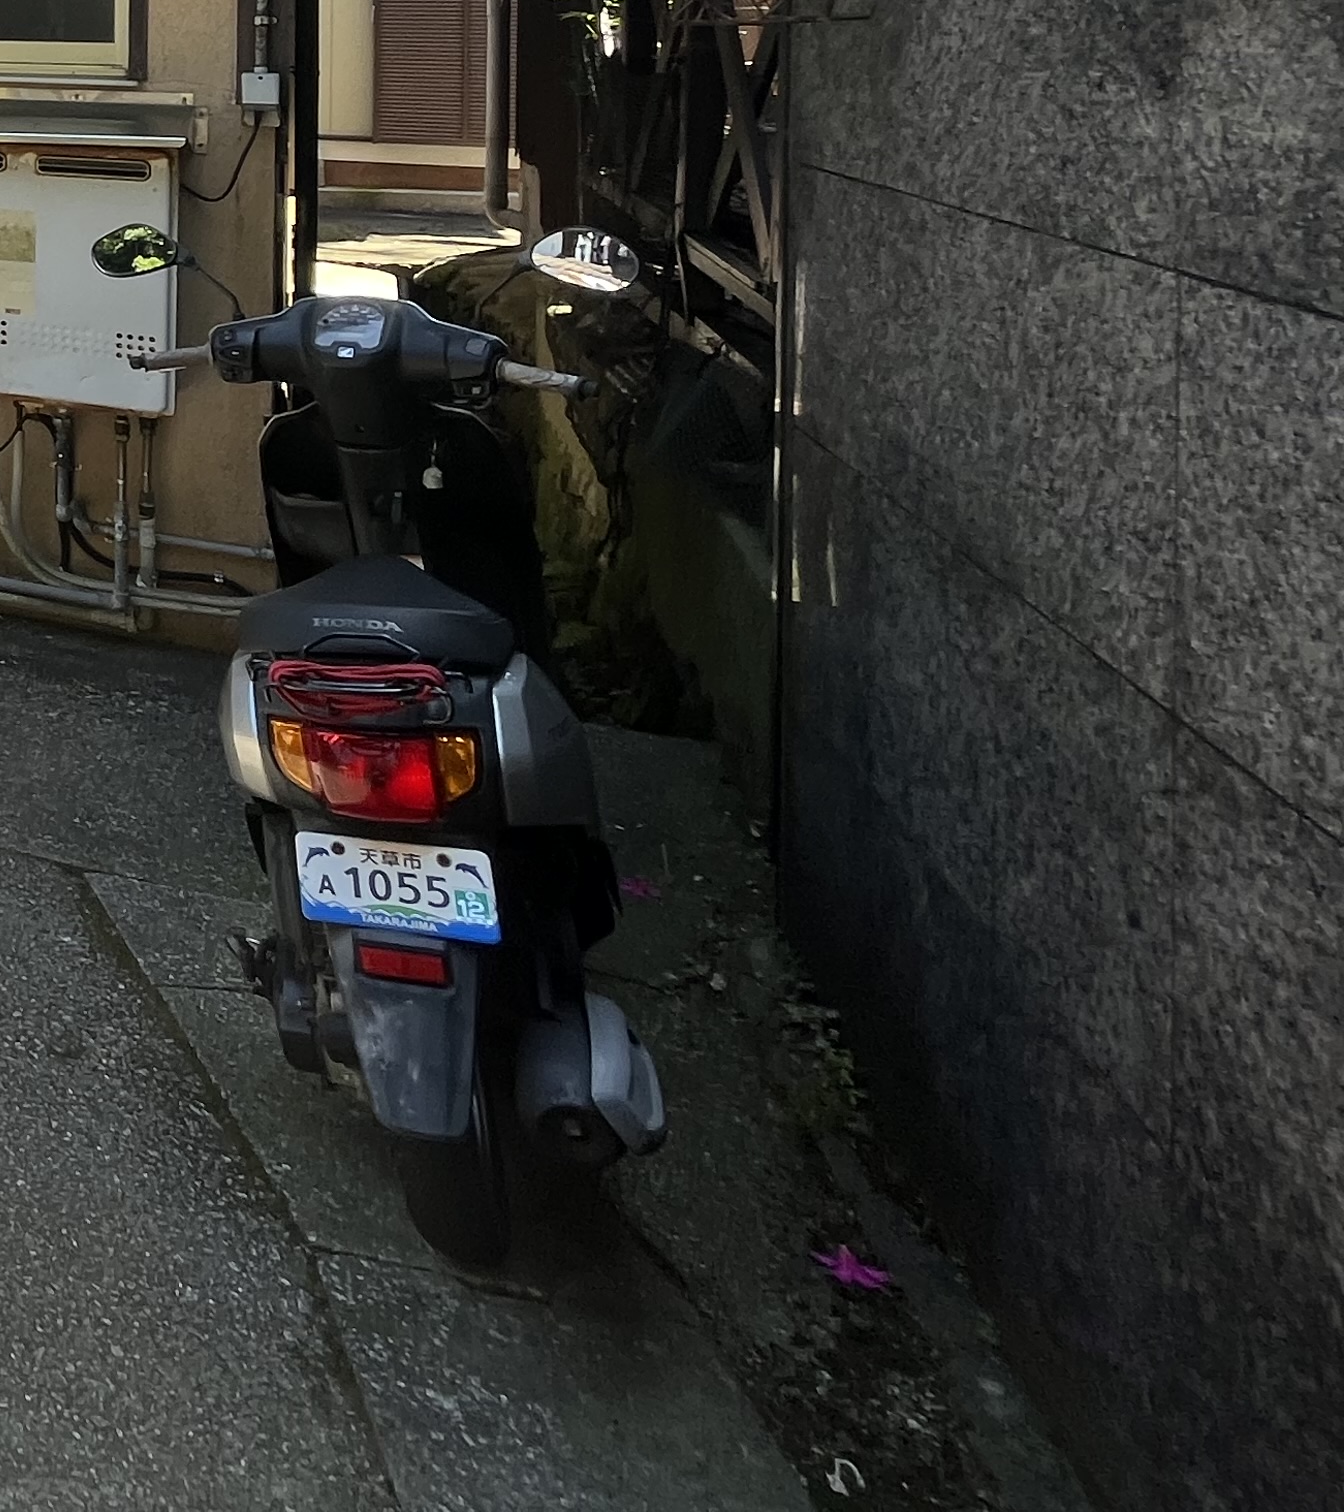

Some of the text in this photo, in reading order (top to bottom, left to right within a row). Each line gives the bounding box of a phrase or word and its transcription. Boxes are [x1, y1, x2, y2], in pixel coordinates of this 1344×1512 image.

[312, 617, 404, 633] HONDA
[359, 847, 422, 870] 天草市
[318, 866, 450, 908] A 1055
[362, 912, 439, 933] TAKARAJIMA
